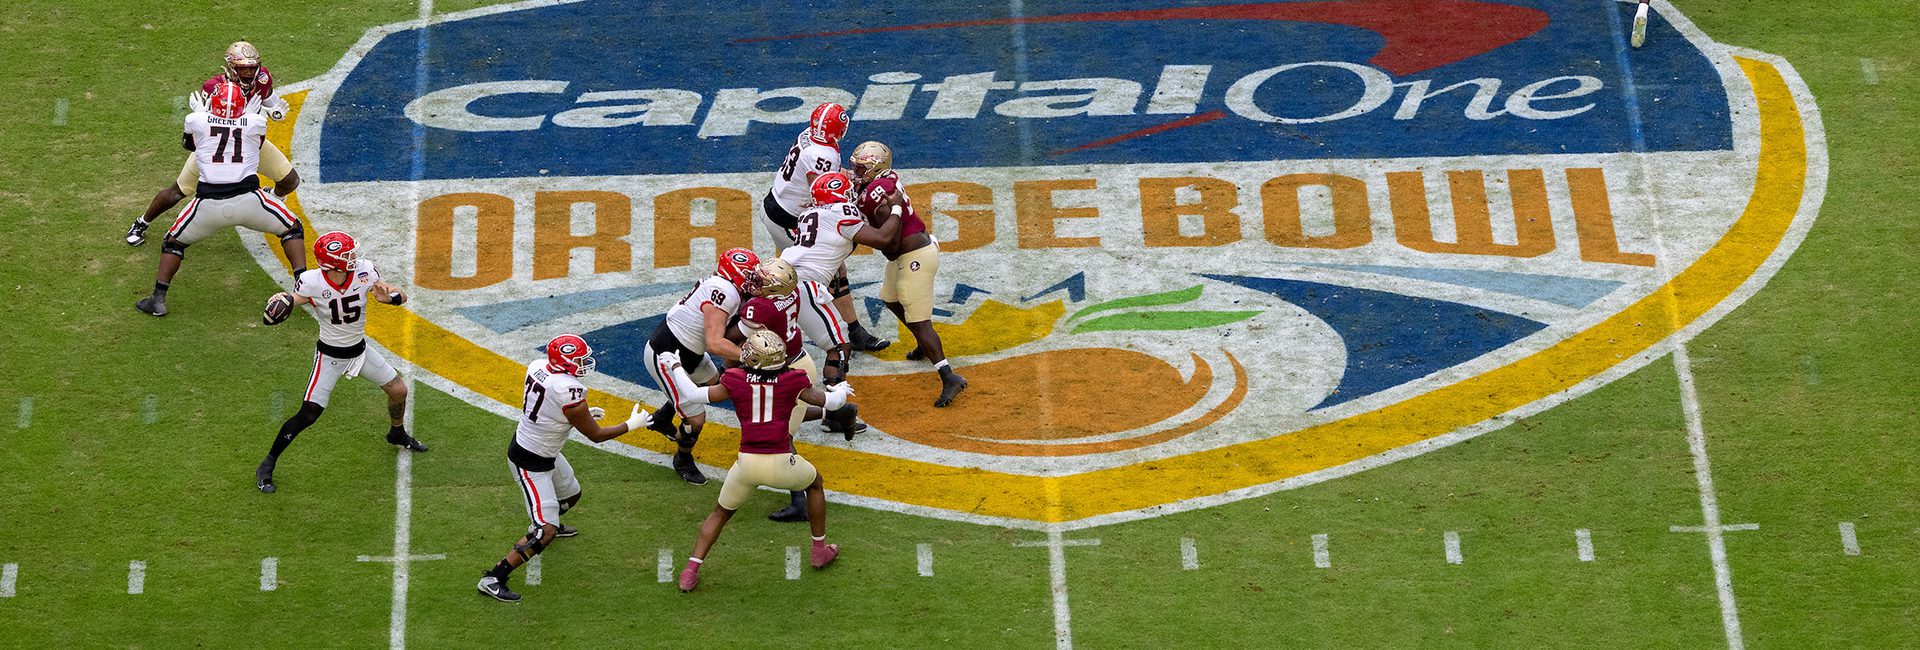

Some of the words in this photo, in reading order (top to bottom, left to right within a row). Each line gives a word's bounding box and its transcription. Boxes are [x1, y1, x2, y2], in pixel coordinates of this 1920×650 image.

[404, 64, 1212, 139] Capital
[1225, 61, 1603, 125] One
[210, 126, 243, 163] 71
[815, 156, 832, 173] 53
[870, 185, 886, 203] 99
[842, 204, 859, 217] 63
[414, 178, 1101, 291] ORAGE
[1138, 167, 1656, 268] BOWL
[328, 293, 362, 325] 15
[710, 289, 727, 306] 69
[746, 306, 755, 319] 6
[523, 374, 546, 423] 77
[568, 387, 584, 401] 77
[750, 384, 774, 424] 11
